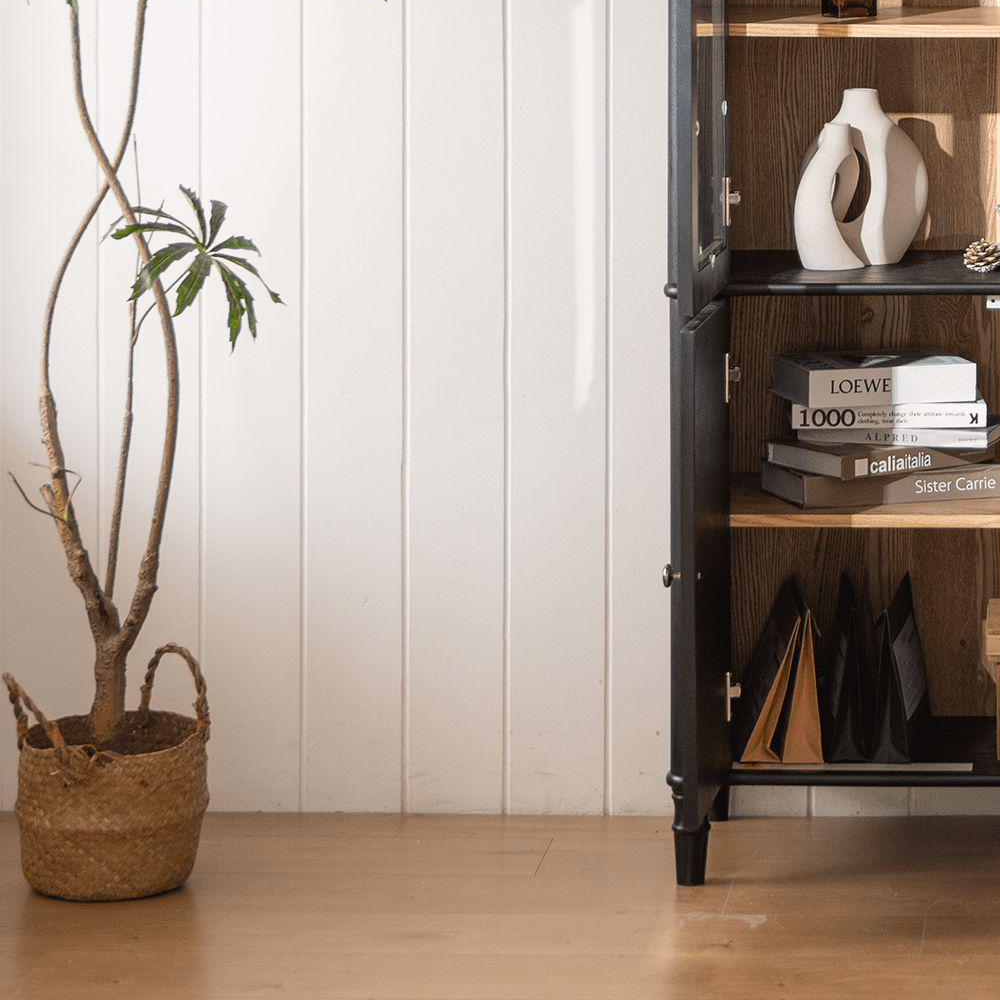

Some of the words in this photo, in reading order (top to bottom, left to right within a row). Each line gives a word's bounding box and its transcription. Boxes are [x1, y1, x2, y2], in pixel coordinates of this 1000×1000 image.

[831, 378, 892, 394] LOEWE
[800, 409, 856, 427] 1000
[857, 411, 887, 419] Completely
[889, 411, 907, 419] change
[865, 433, 918, 443] ALPRED
[870, 452, 932, 474] caliaitalia
[915, 479, 952, 493] Sister
[955, 476, 996, 491] Carrie
